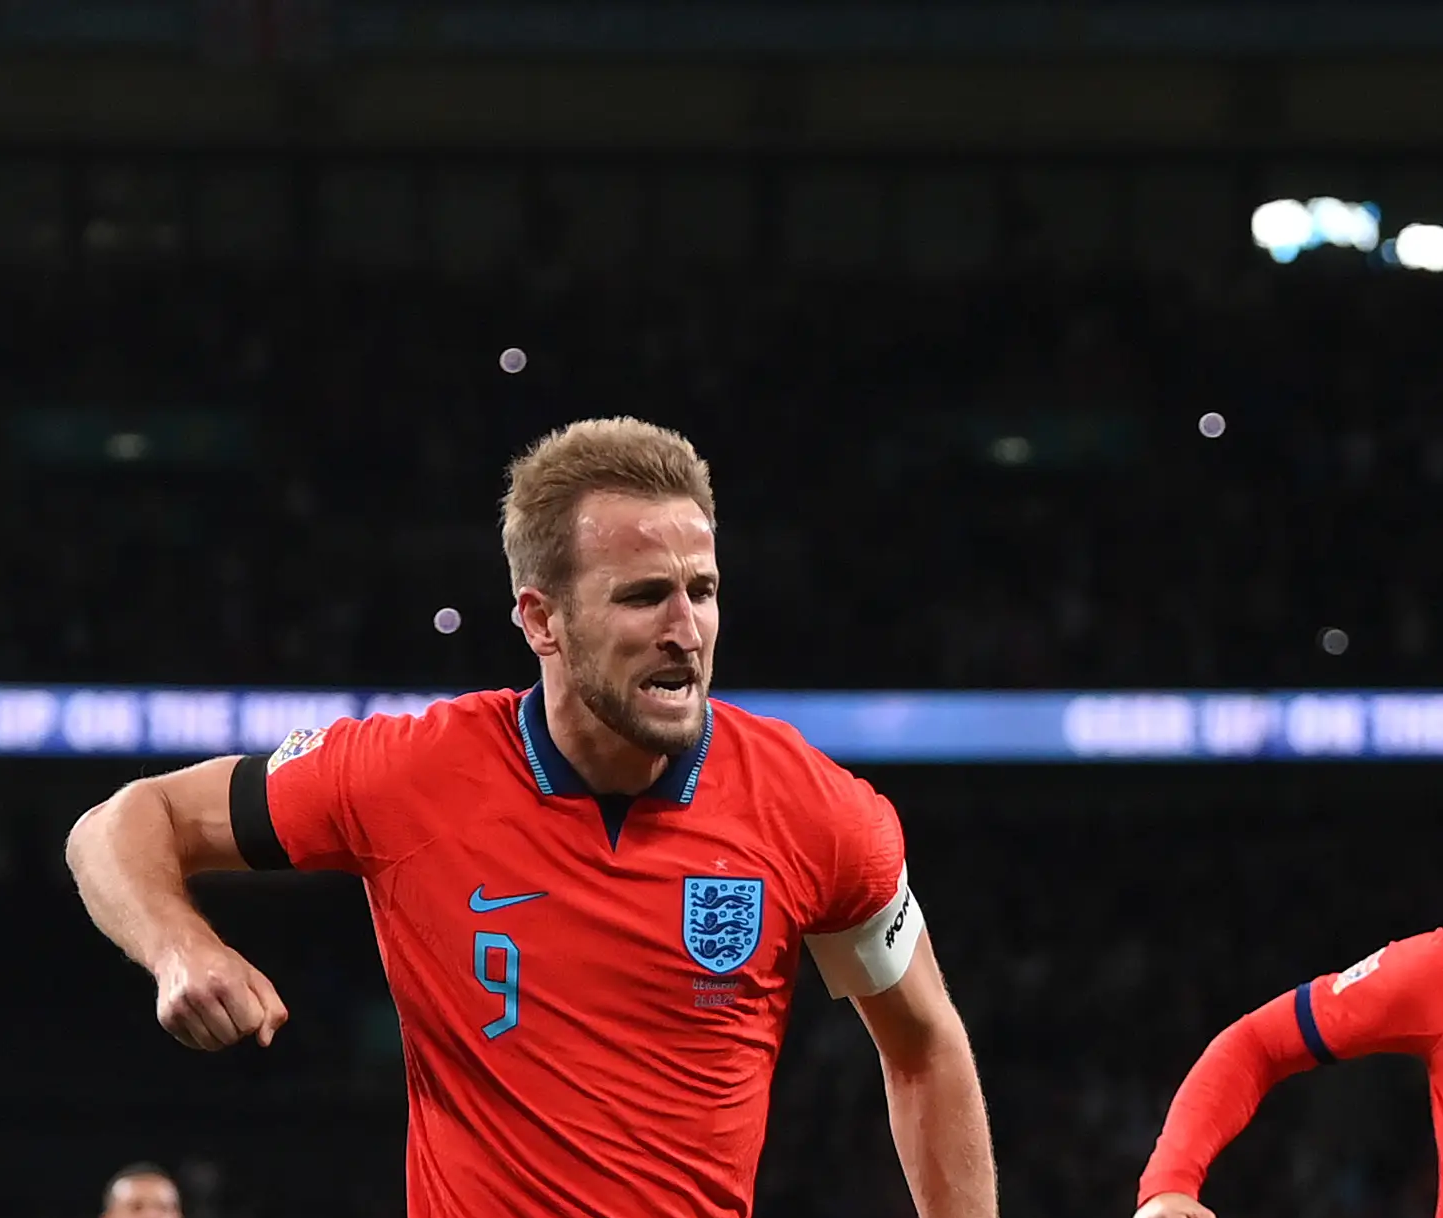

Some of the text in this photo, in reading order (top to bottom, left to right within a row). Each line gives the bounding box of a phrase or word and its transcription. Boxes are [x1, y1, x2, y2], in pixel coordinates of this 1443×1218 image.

[62, 691, 142, 749] ON
[146, 692, 237, 751] THE
[1285, 693, 1365, 753] ON
[473, 930, 521, 1040] 9
